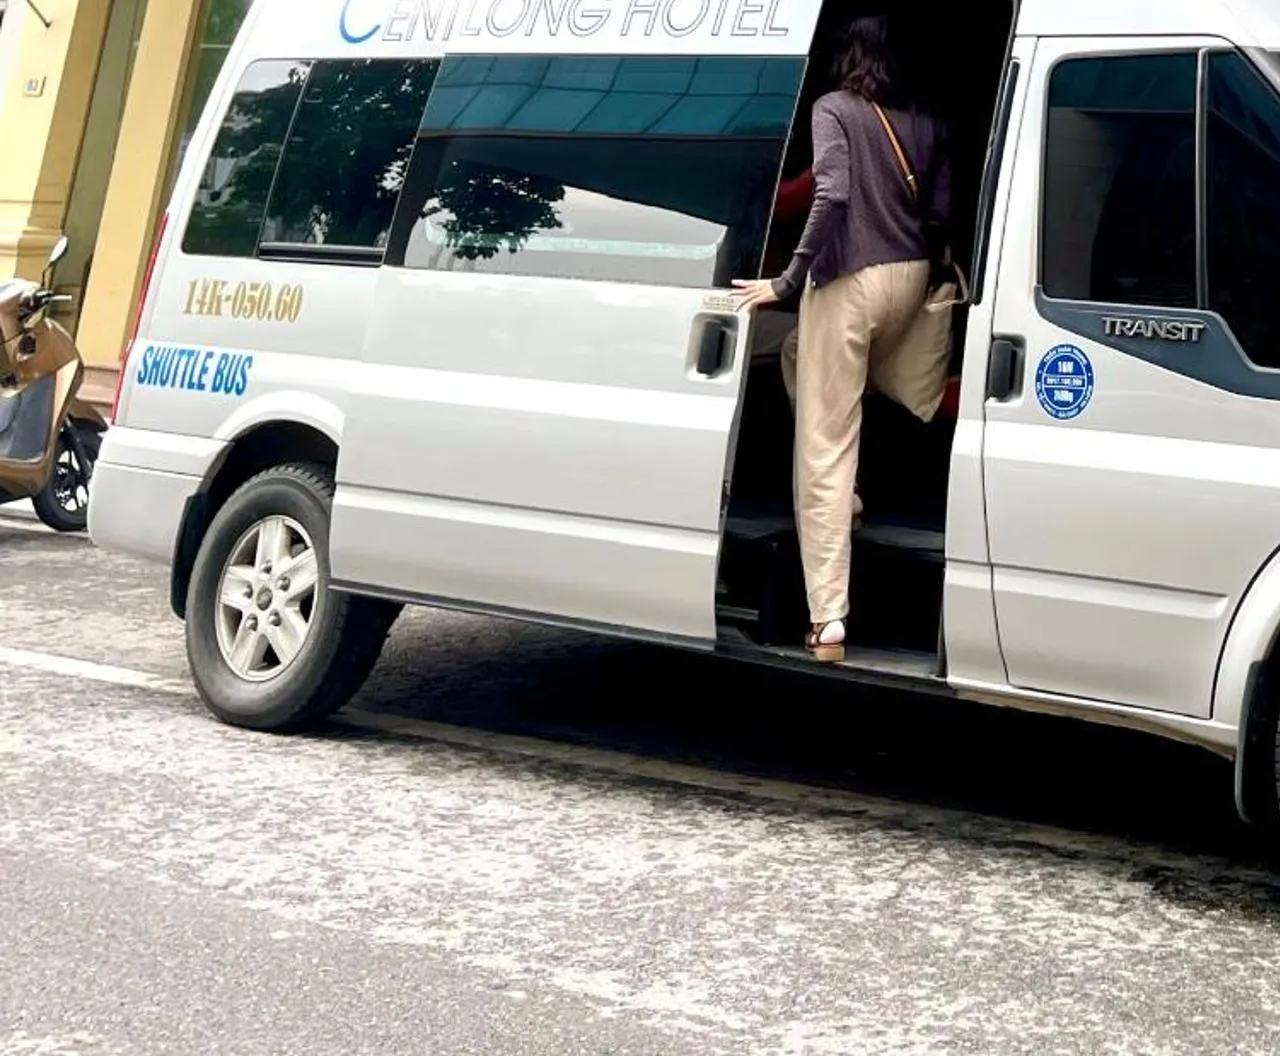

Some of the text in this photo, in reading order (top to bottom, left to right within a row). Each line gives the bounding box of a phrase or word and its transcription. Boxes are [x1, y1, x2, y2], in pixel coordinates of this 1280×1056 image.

[182, 277, 303, 323] 14K-050.60
[1102, 317, 1205, 342] TRANSIT
[137, 345, 253, 397] SHUTTLE BUS
